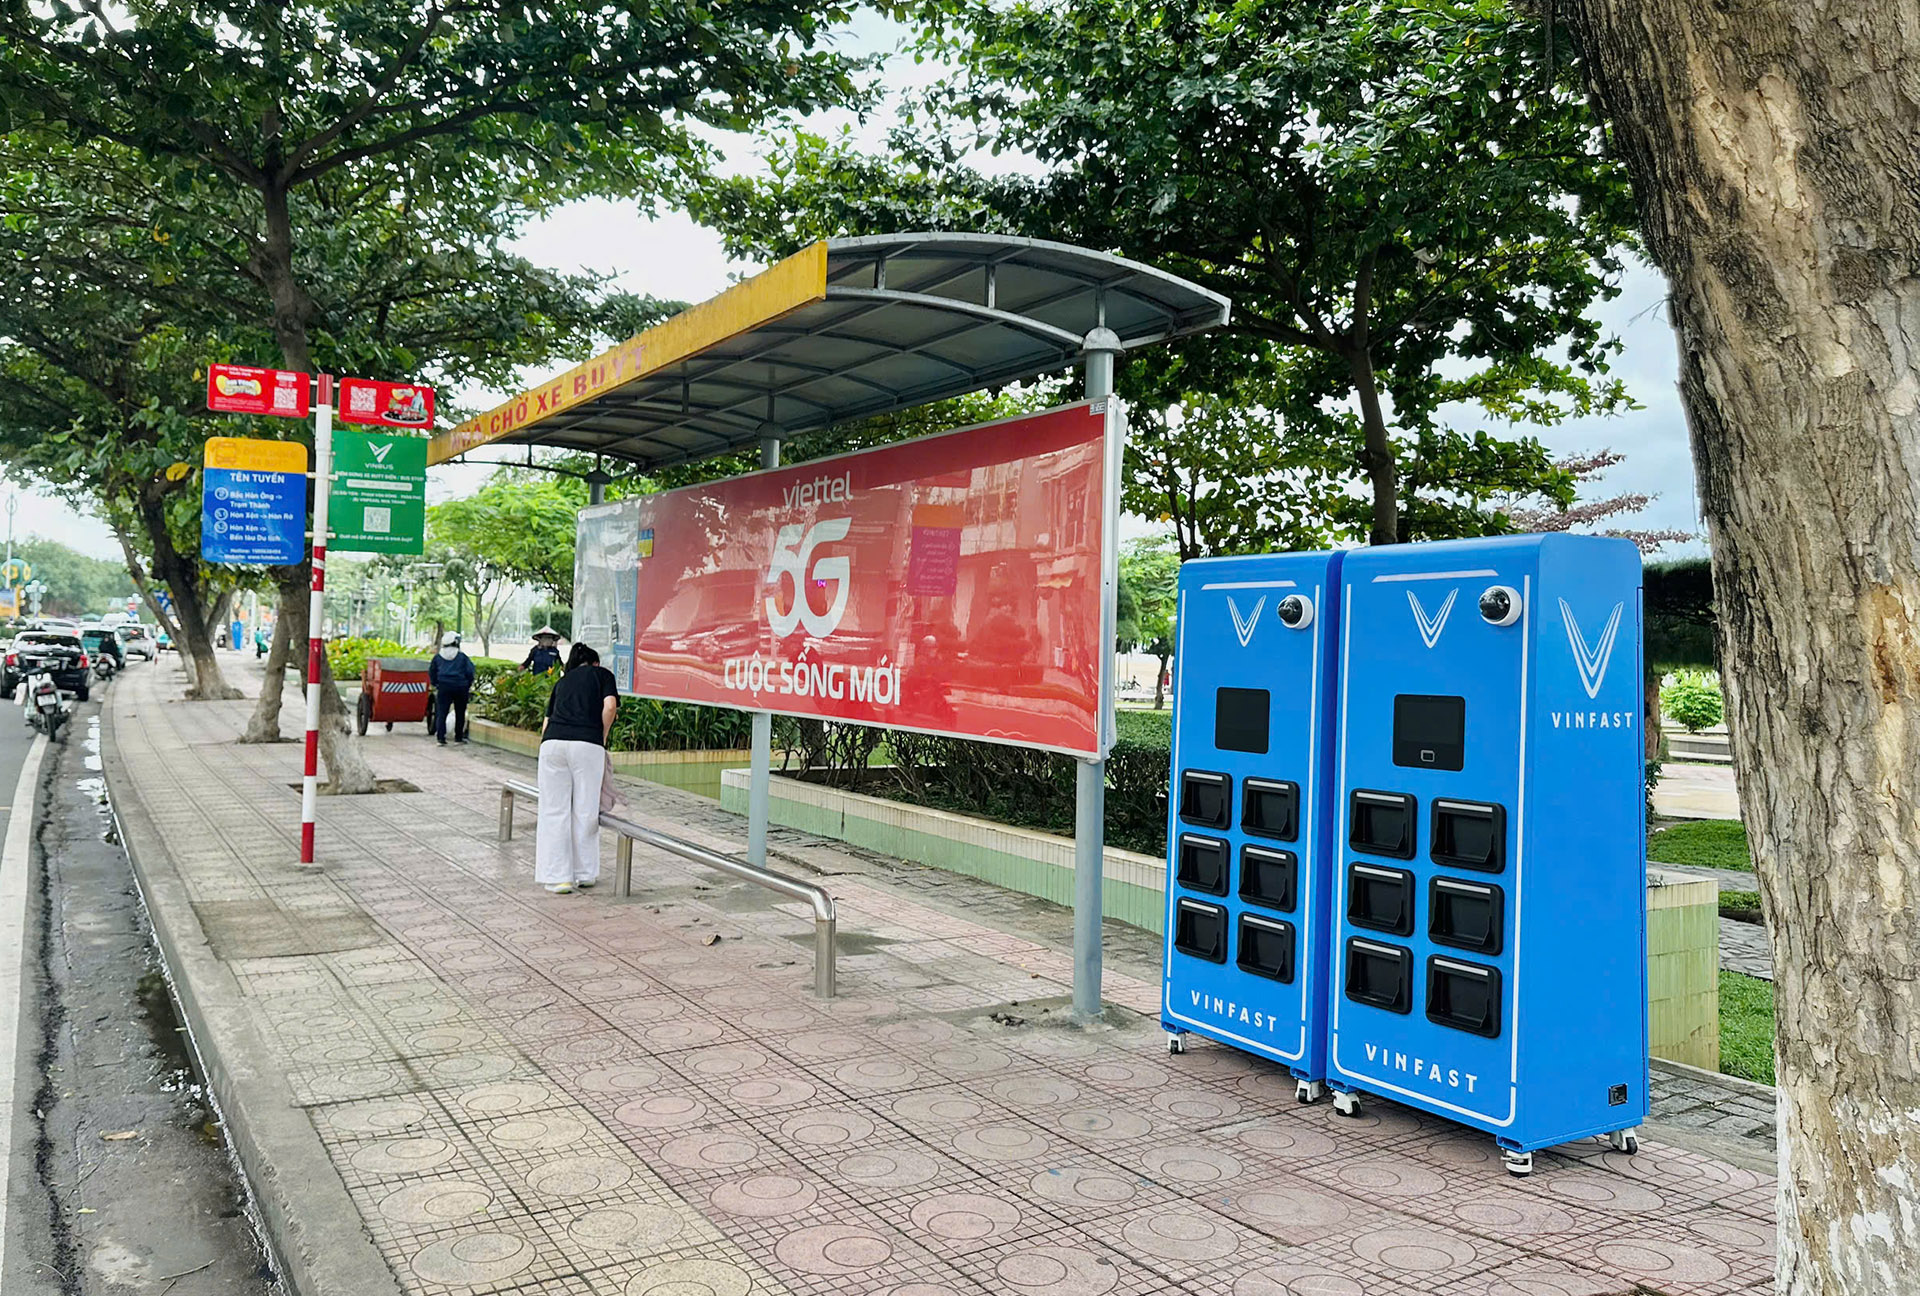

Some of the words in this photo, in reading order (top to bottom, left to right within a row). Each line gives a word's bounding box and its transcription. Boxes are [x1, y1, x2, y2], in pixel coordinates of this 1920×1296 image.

[490, 396, 528, 435] CHỜ
[536, 384, 563, 415] XE
[230, 471, 250, 482] TÊN
[252, 472, 285, 484] TUYẾN
[365, 463, 394, 471] VINBUS
[783, 470, 854, 510] viettel
[765, 517, 852, 638] 5G
[724, 650, 775, 698] CUỘC
[780, 645, 844, 700] SỐNG
[850, 654, 900, 705] MỚI
[1551, 712, 1633, 728] VINFAST
[1191, 990, 1277, 1032] VINFAST
[1365, 1043, 1478, 1093] VINFAST
